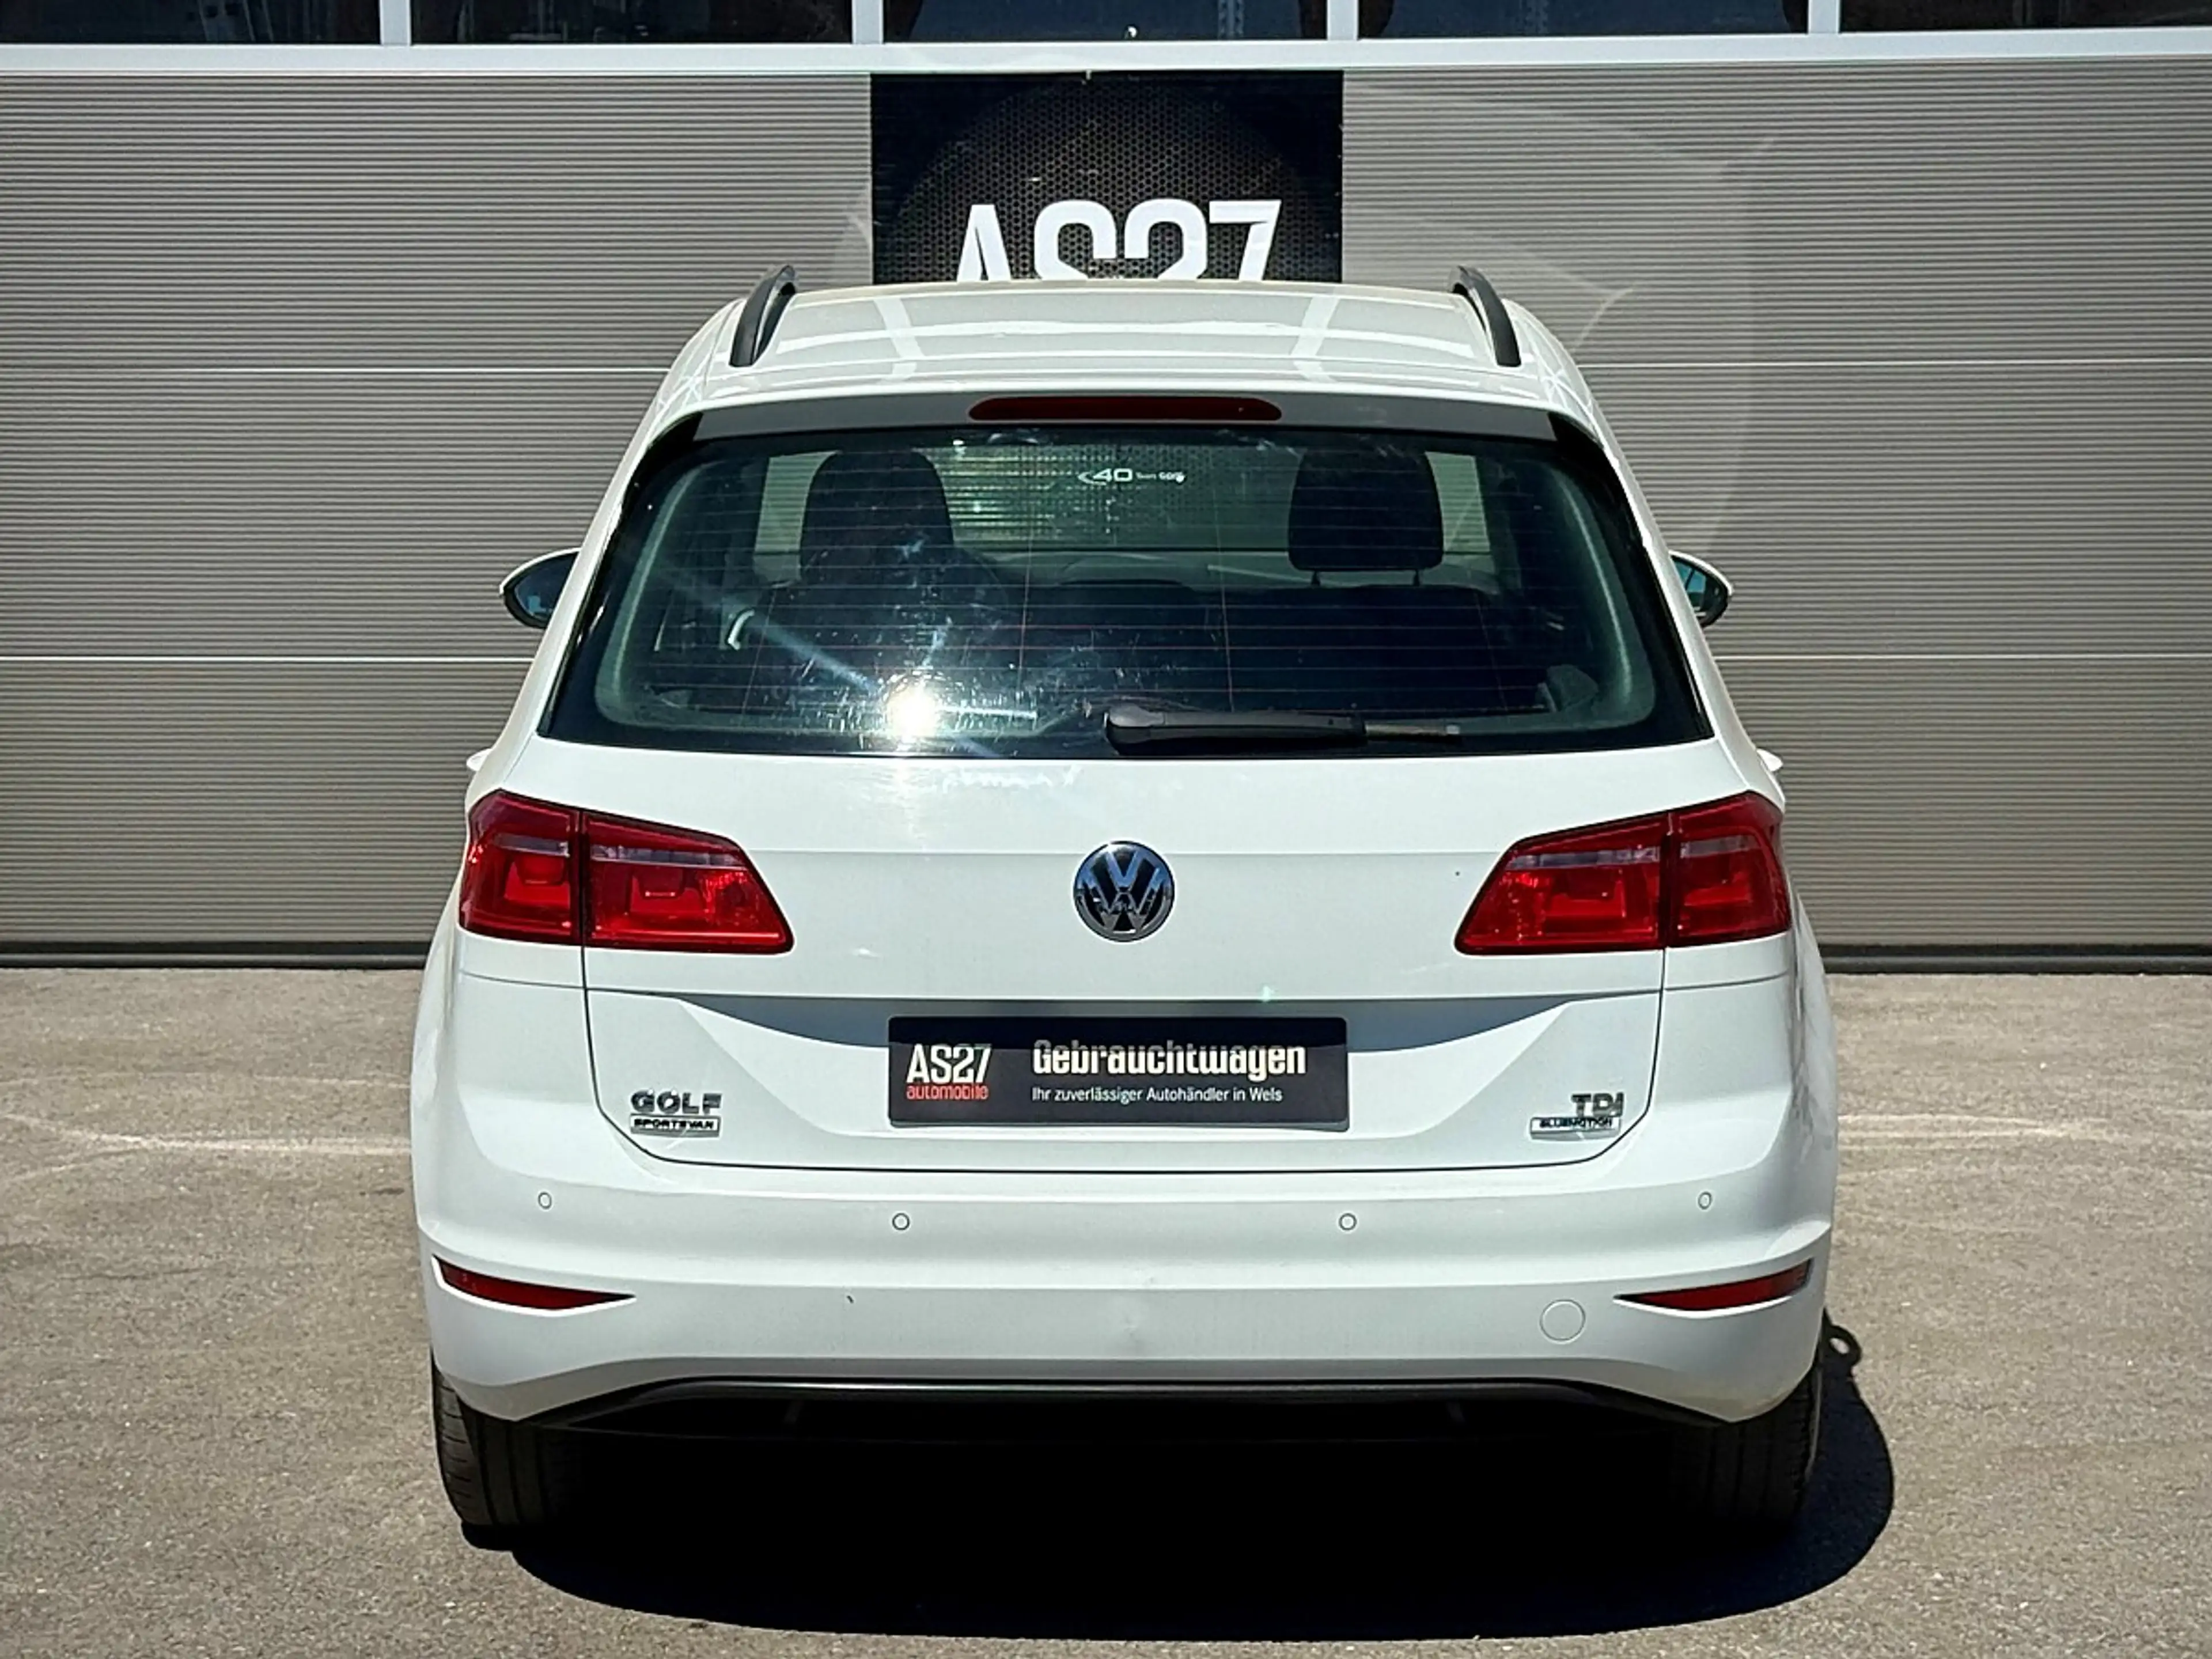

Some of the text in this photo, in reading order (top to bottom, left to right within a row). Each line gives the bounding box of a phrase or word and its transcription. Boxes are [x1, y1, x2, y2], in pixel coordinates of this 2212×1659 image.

[906, 1043, 992, 1084] AS27
[1034, 1040, 1306, 1081] Gebrauchtwagen
[631, 1090, 722, 1114] GOLF
[906, 1085, 988, 1100] automobile
[1032, 1086, 1283, 1105] Ihr zuverlässiger Autohändler in Wels
[1571, 1092, 1624, 1117] TDI
